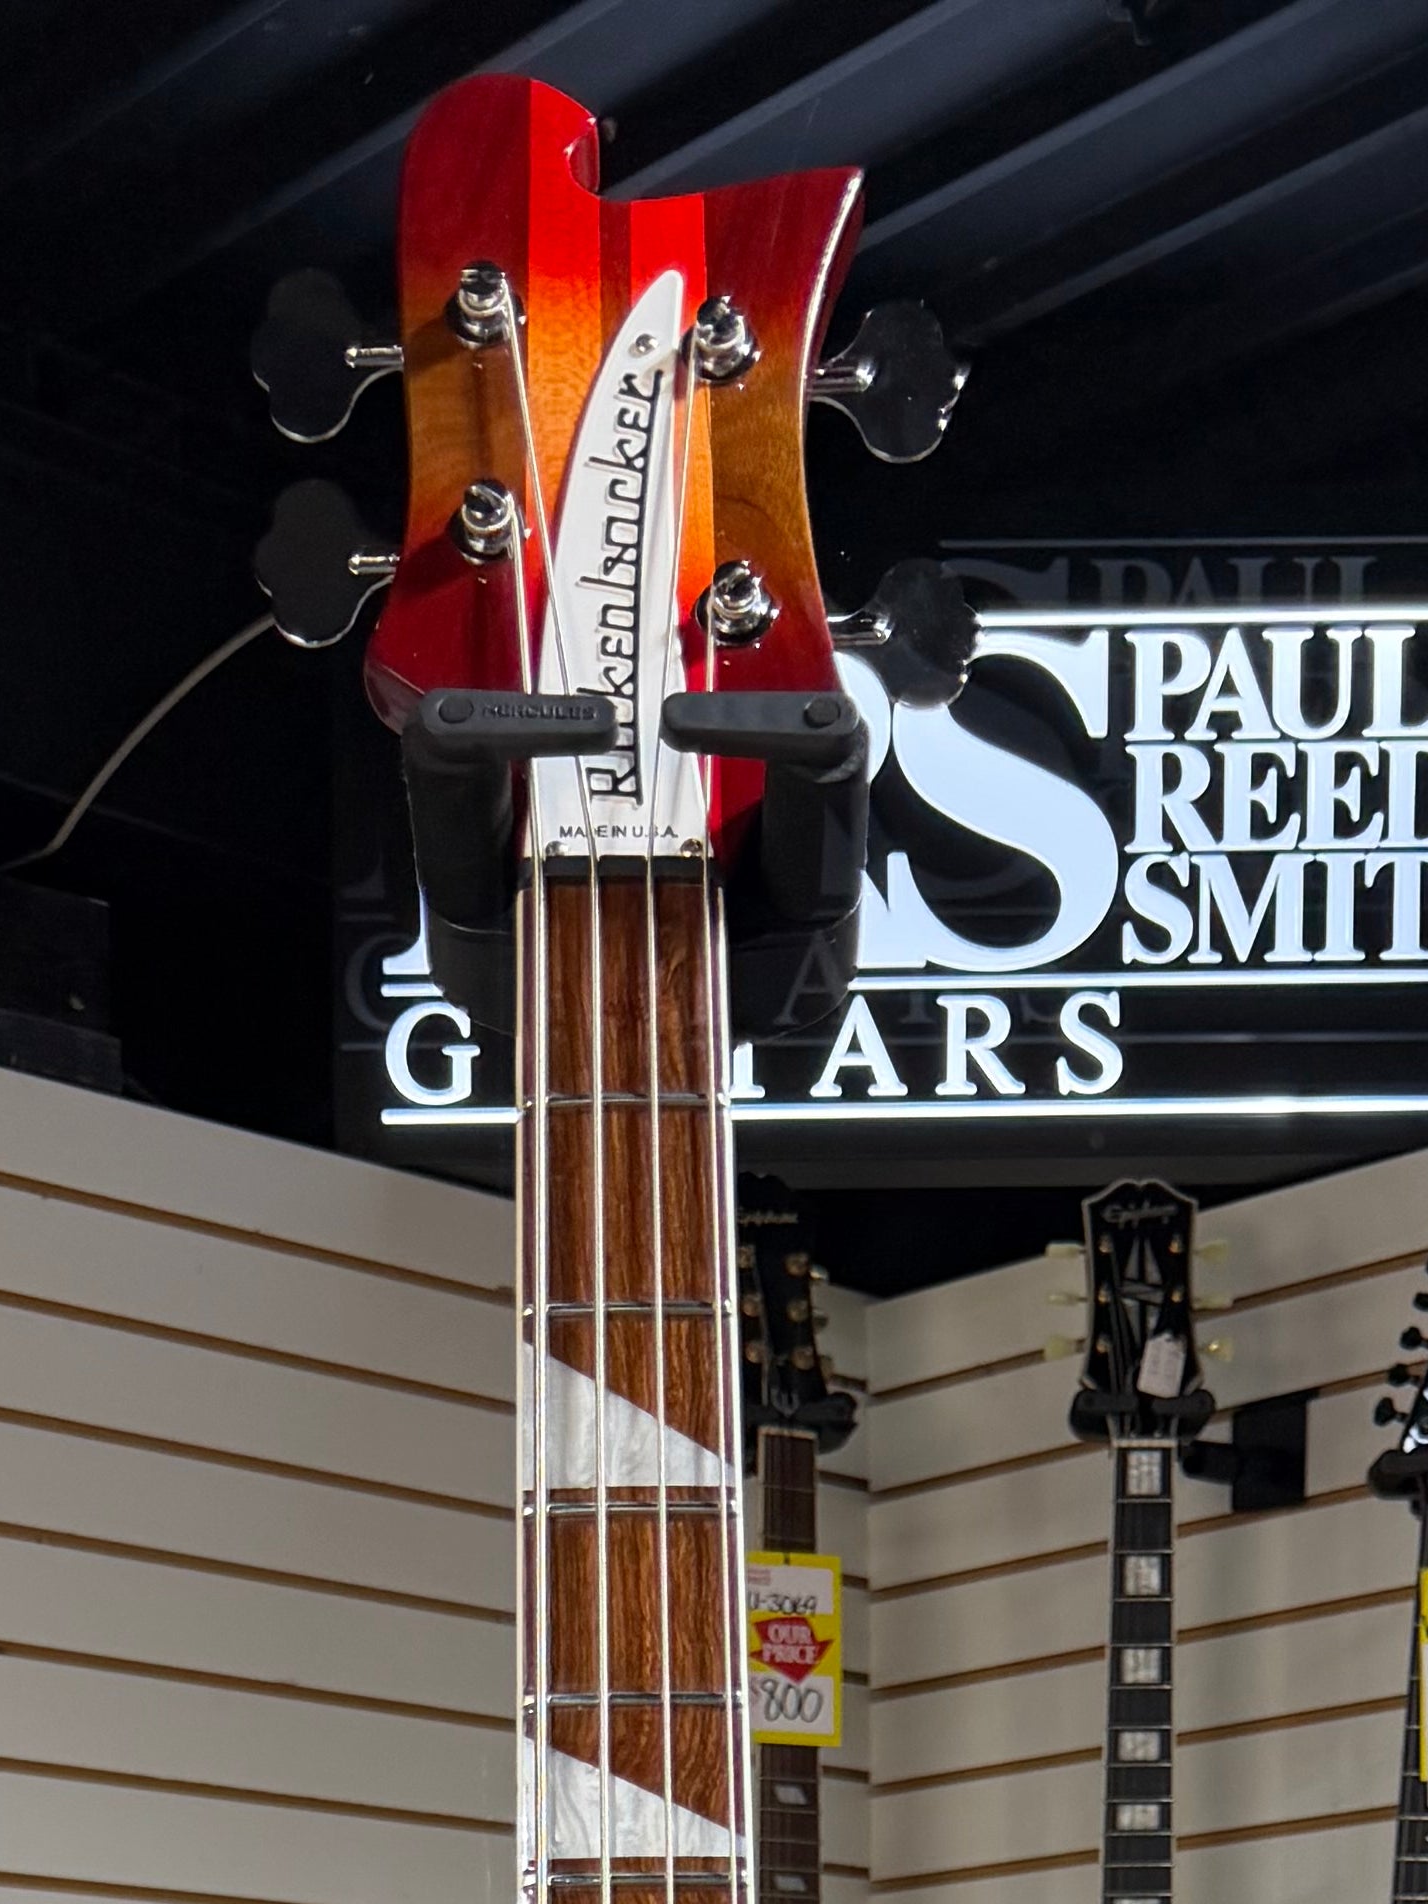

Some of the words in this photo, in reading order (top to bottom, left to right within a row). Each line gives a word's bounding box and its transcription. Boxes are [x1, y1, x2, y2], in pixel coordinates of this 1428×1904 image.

[384, 988, 1126, 1106] GARS
[767, 1623, 812, 1645] OUR
[762, 1642, 819, 1665] PRICE
